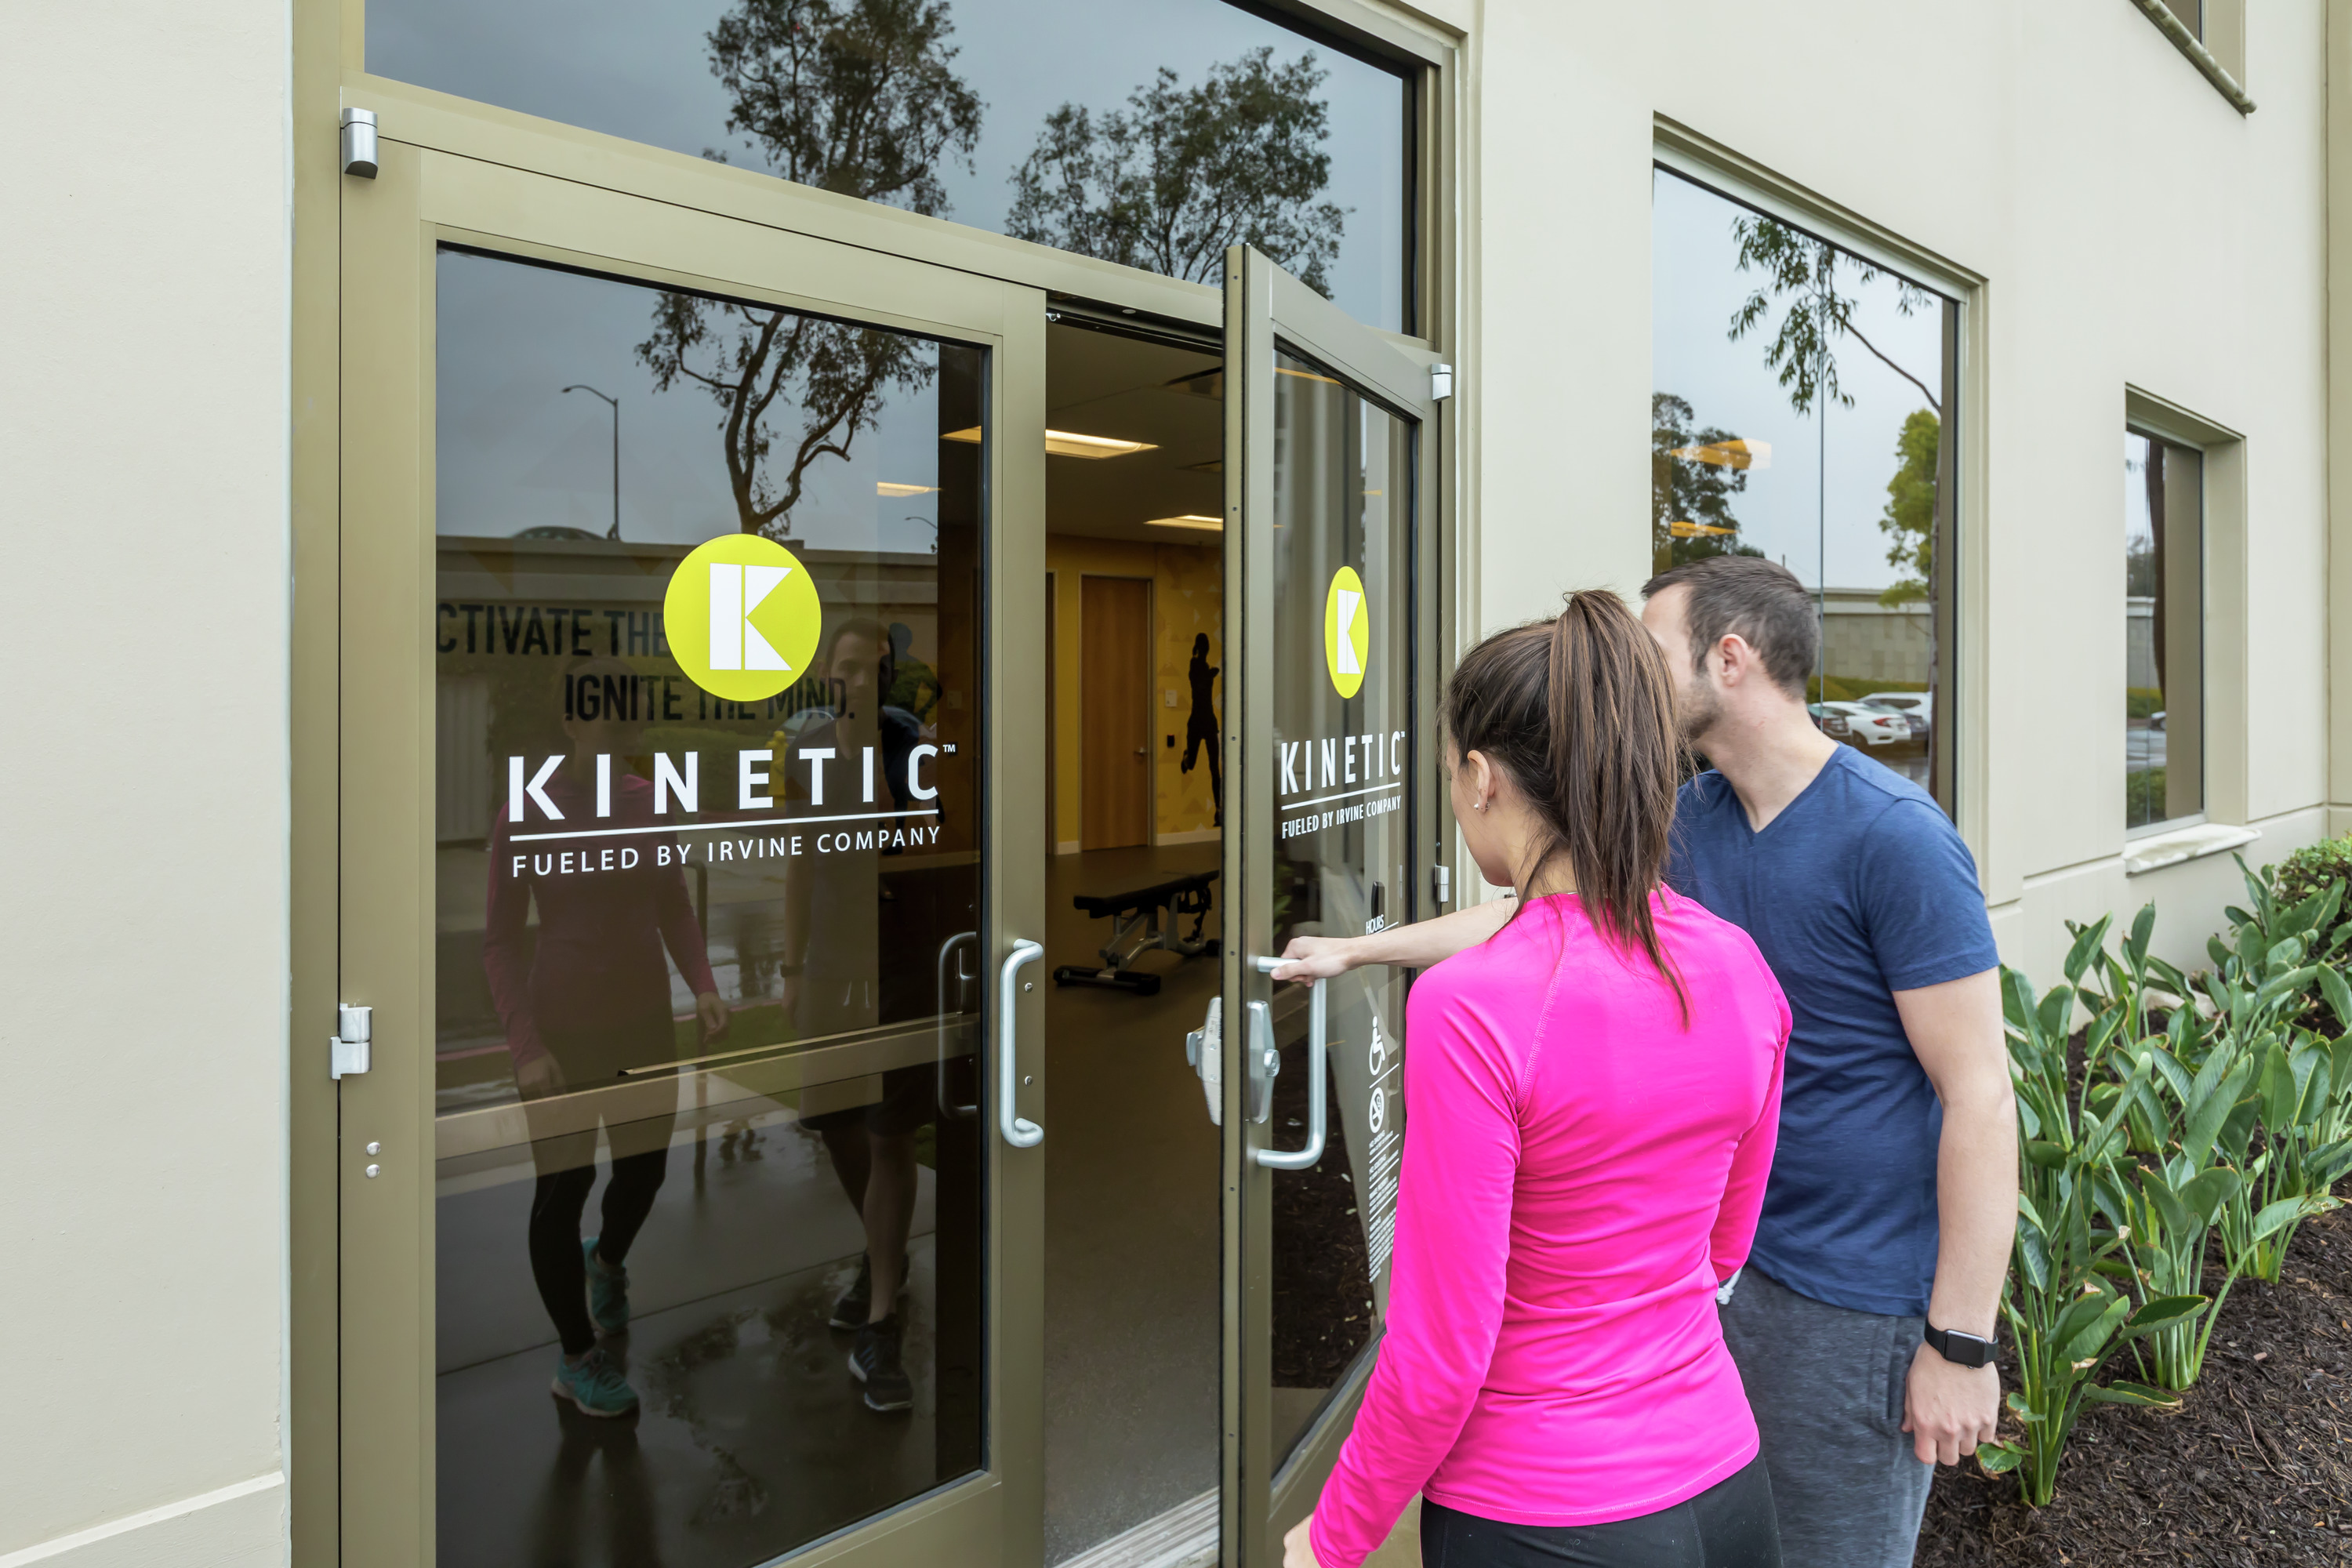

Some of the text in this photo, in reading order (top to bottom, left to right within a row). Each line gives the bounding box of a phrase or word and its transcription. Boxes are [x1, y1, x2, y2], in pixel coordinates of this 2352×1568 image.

[436, 603, 592, 656] CTIVATE
[565, 674, 682, 720] IGNITE
[1282, 794, 1401, 839] FUELED BY IRVINE COMPANY
[513, 826, 940, 878] FUELED BY IRVINE COMPANY
